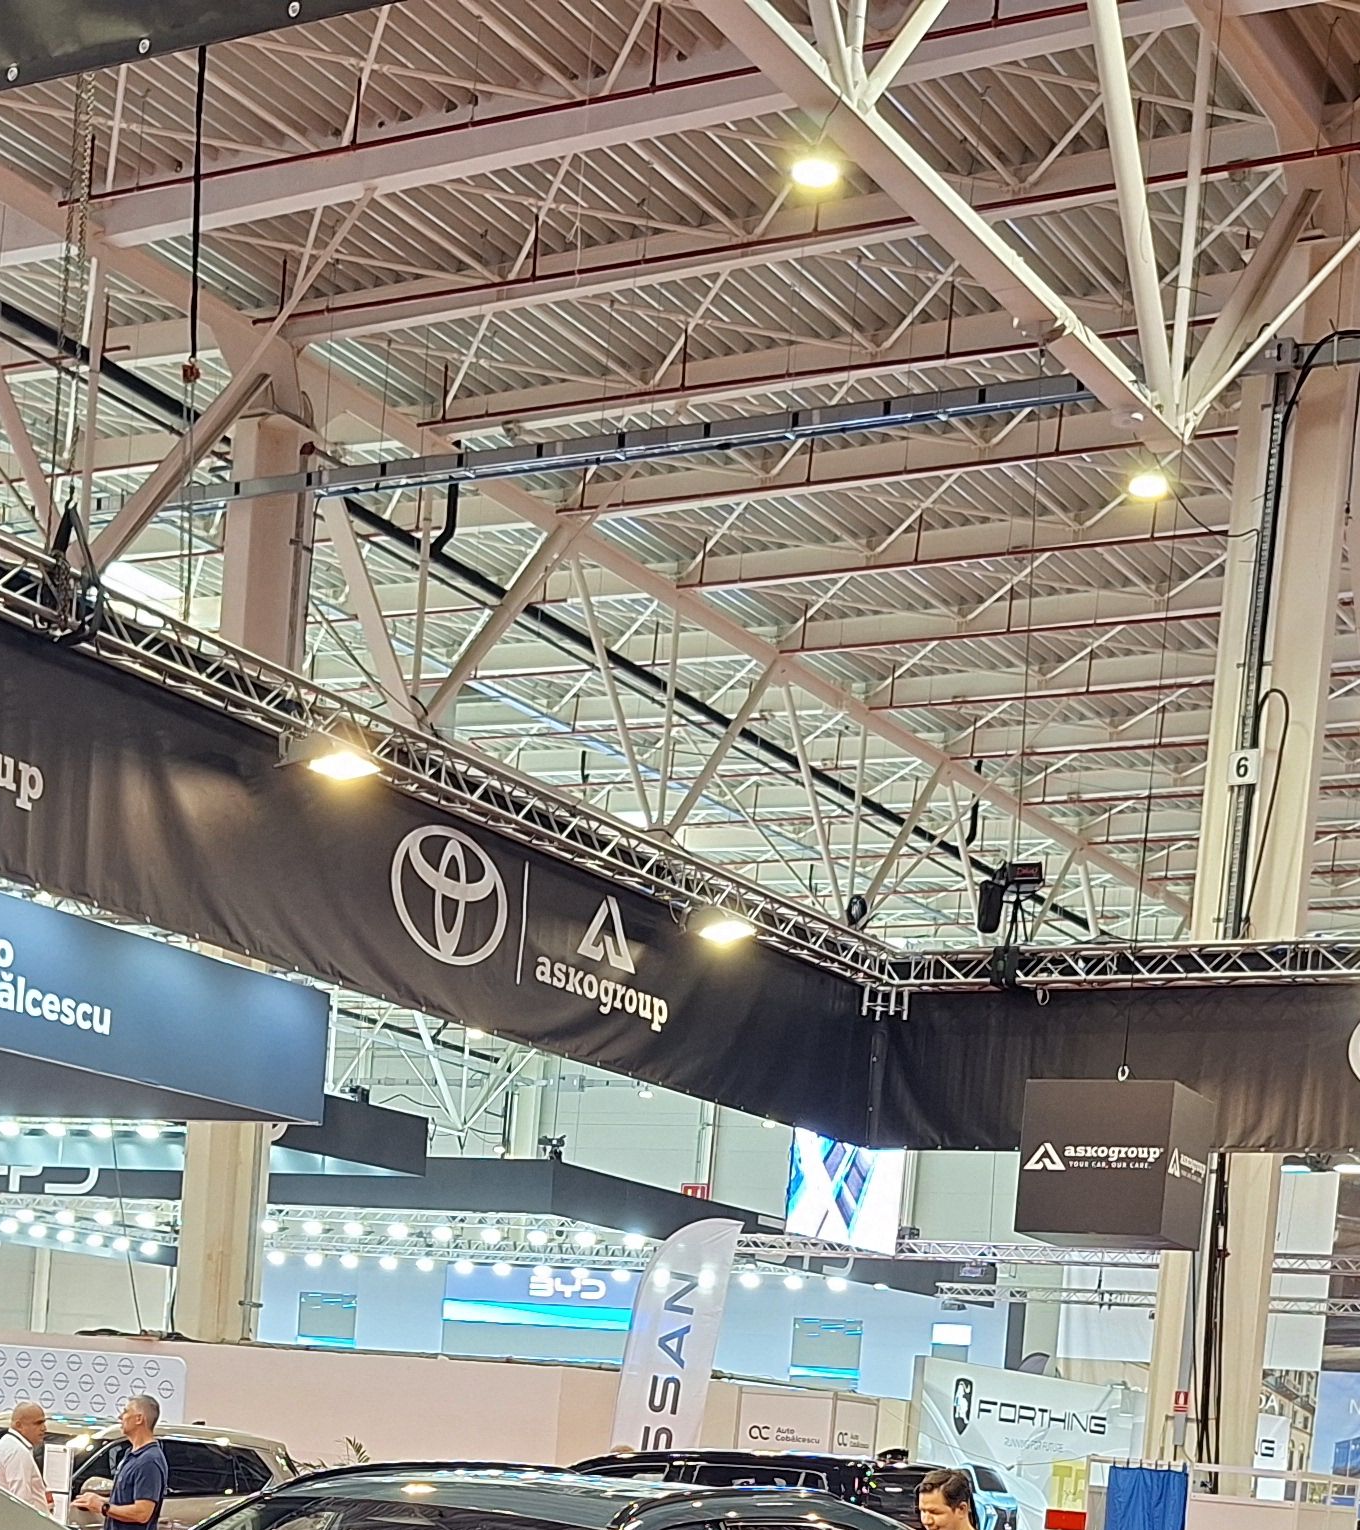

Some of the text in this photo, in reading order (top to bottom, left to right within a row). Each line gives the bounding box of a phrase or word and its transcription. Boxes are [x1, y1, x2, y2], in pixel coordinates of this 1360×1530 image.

[1236, 756, 1249, 778] 6
[535, 956, 669, 1033] askogroup
[1064, 1145, 1162, 1162] askogroup
[529, 1275, 606, 1300] BYD
[642, 1270, 699, 1450] SSAN
[978, 1399, 1107, 1435] FORTHING
